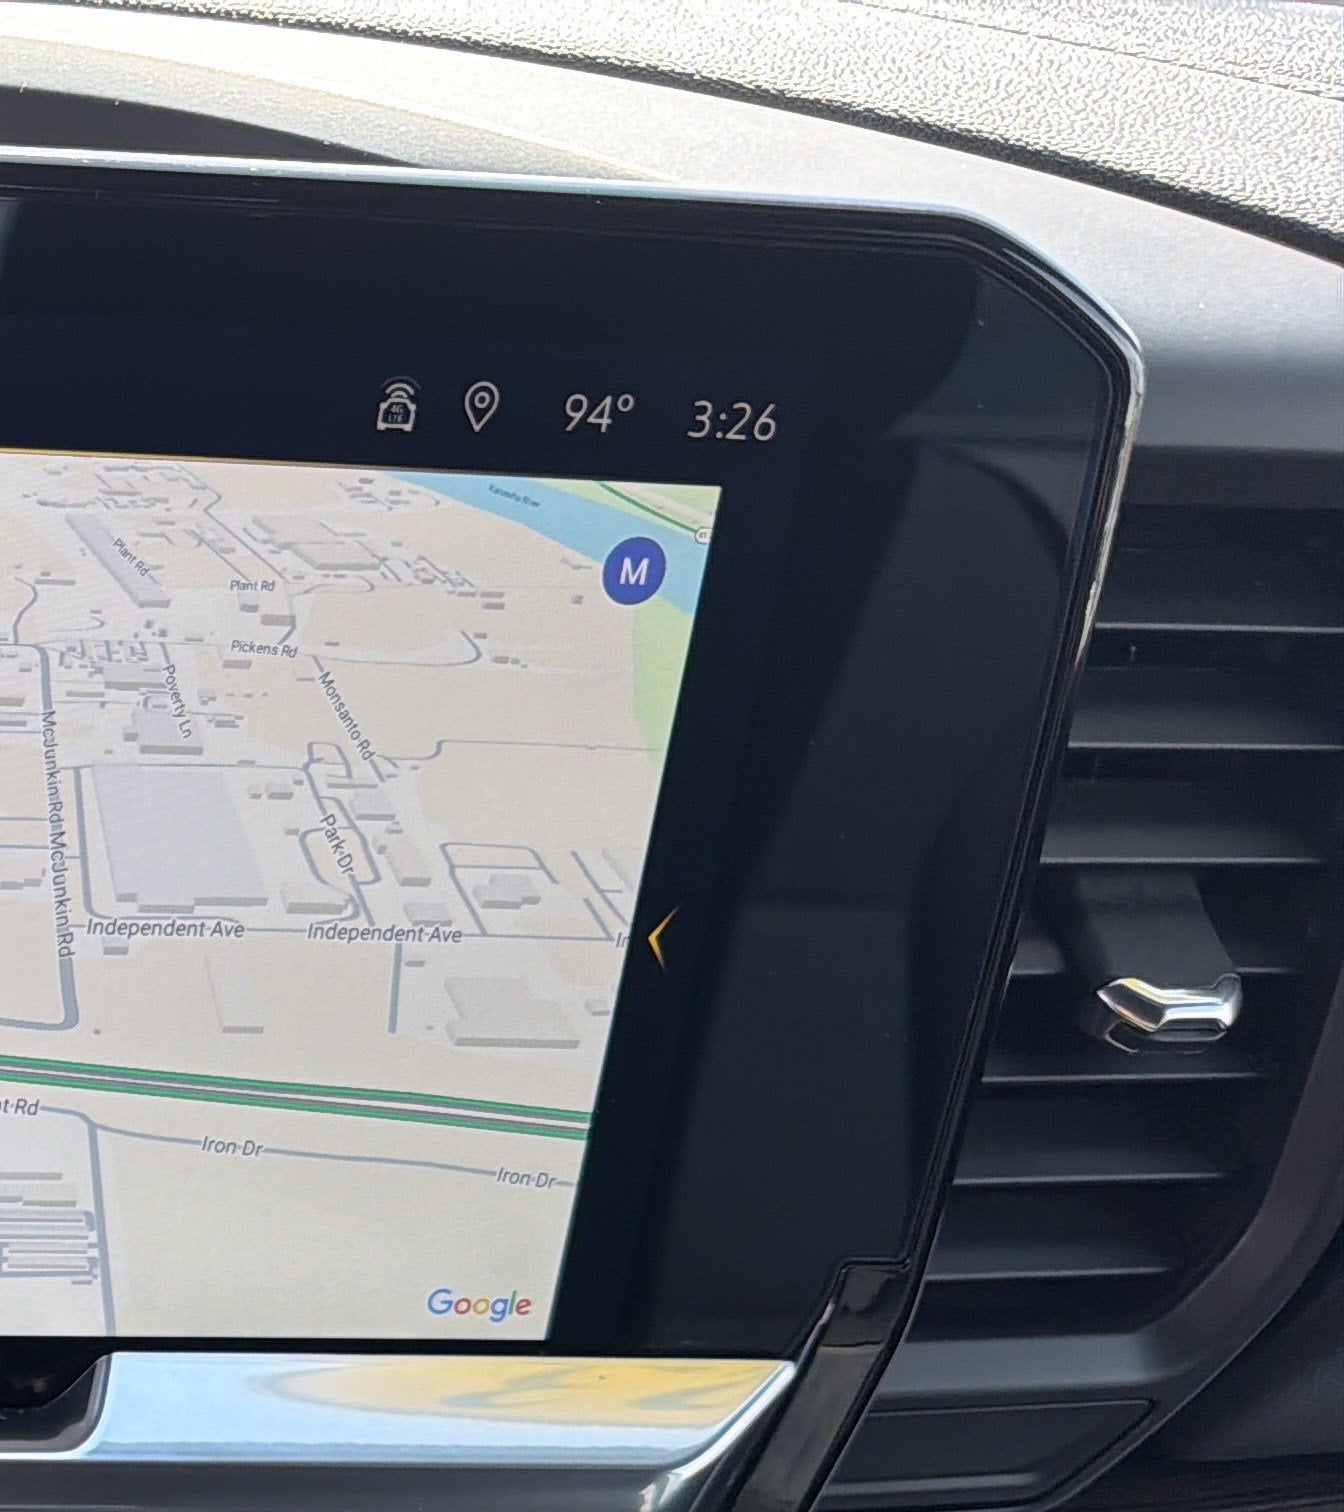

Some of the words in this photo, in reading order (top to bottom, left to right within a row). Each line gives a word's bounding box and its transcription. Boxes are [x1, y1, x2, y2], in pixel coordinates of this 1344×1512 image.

[564, 394, 635, 433] 94°
[688, 399, 777, 441] 3:26
[113, 538, 137, 564] Plant
[133, 561, 150, 577] Rd
[618, 556, 649, 586] M
[230, 579, 258, 591] Plant
[261, 580, 275, 591] Rd
[231, 640, 279, 656] Pickens
[280, 644, 298, 658] Rd
[162, 664, 187, 720] Poverty
[178, 720, 192, 739] Ln
[318, 671, 362, 741] Monsanto
[358, 738, 375, 761] Rd
[42, 710, 61, 797] McJunkin
[49, 801, 63, 824] Rd
[320, 813, 345, 854] Park
[335, 852, 355, 876] Dr
[50, 831, 70, 928] McJunkin
[86, 917, 207, 938] Independent
[209, 921, 245, 938] Ave
[307, 923, 425, 944] Independent
[427, 926, 462, 943] Ave
[58, 932, 75, 957] Rd
[15, 1098, 39, 1116] Rd
[201, 1135, 237, 1155] Iron
[241, 1140, 263, 1157] Dr
[496, 1166, 531, 1186] Iron
[535, 1171, 557, 1189] Dr
[427, 1287, 533, 1323] Google
